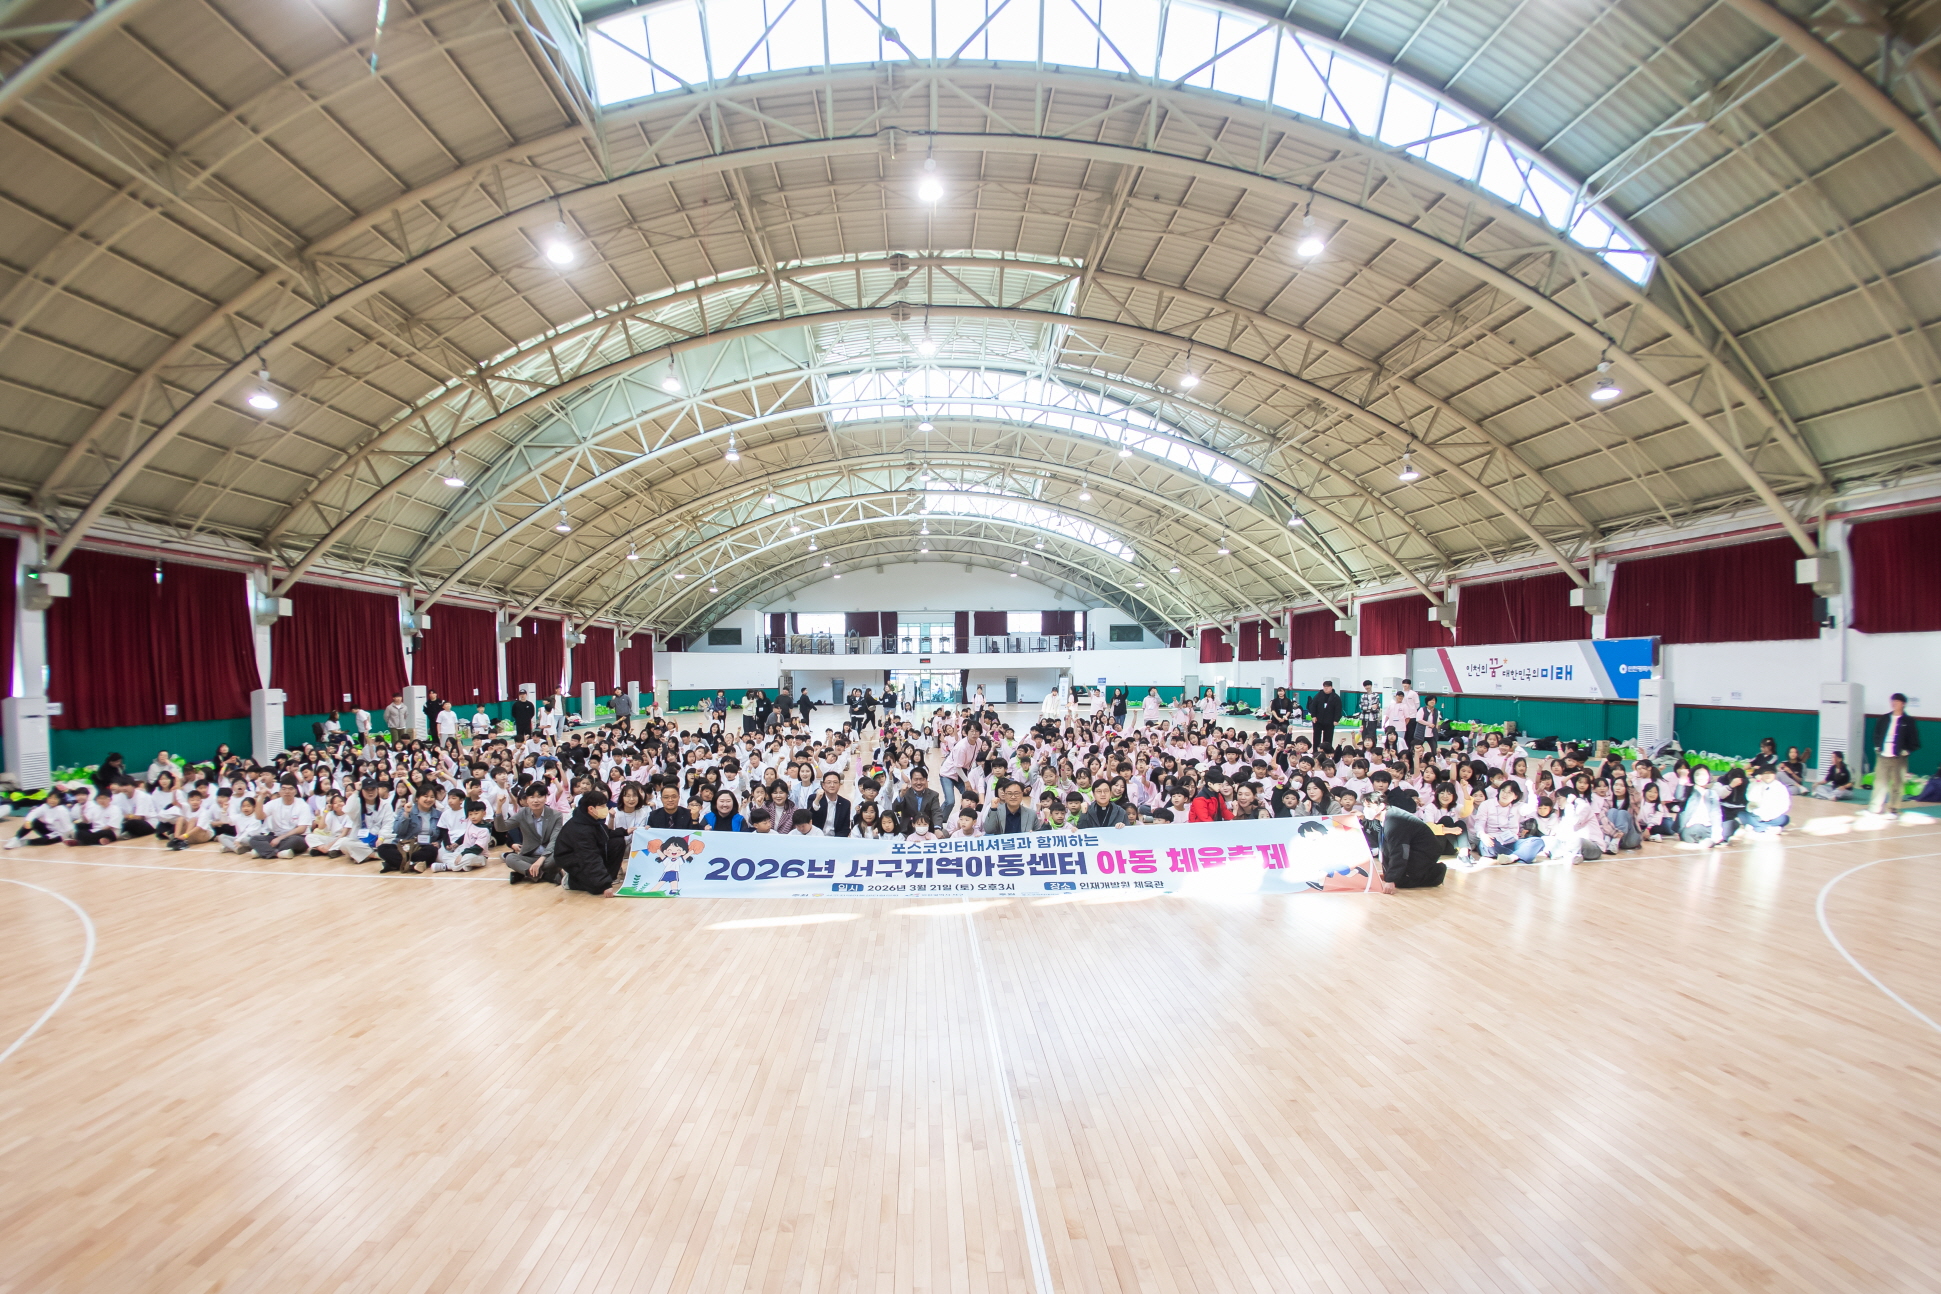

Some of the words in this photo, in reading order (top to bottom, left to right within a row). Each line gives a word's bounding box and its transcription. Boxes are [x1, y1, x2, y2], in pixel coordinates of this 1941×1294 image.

[1466, 663, 1487, 677] 인천의
[1489, 658, 1504, 678] 꿈
[1502, 668, 1539, 681] 대한민국의
[1540, 665, 1572, 681] 미래
[892, 837, 1031, 855] 포스코인터내셔널과
[1036, 834, 1099, 849] 함께하는
[704, 857, 836, 881] 2026년
[845, 851, 1088, 879] 서구지역아동센터
[1096, 849, 1158, 875] 아동
[867, 884, 906, 892] 2026년
[909, 884, 926, 892] 3월
[955, 883, 974, 891] (토)
[977, 883, 1015, 891] 오후3시
[1050, 882, 1071, 890] 장소
[1133, 880, 1164, 889] 체육관
